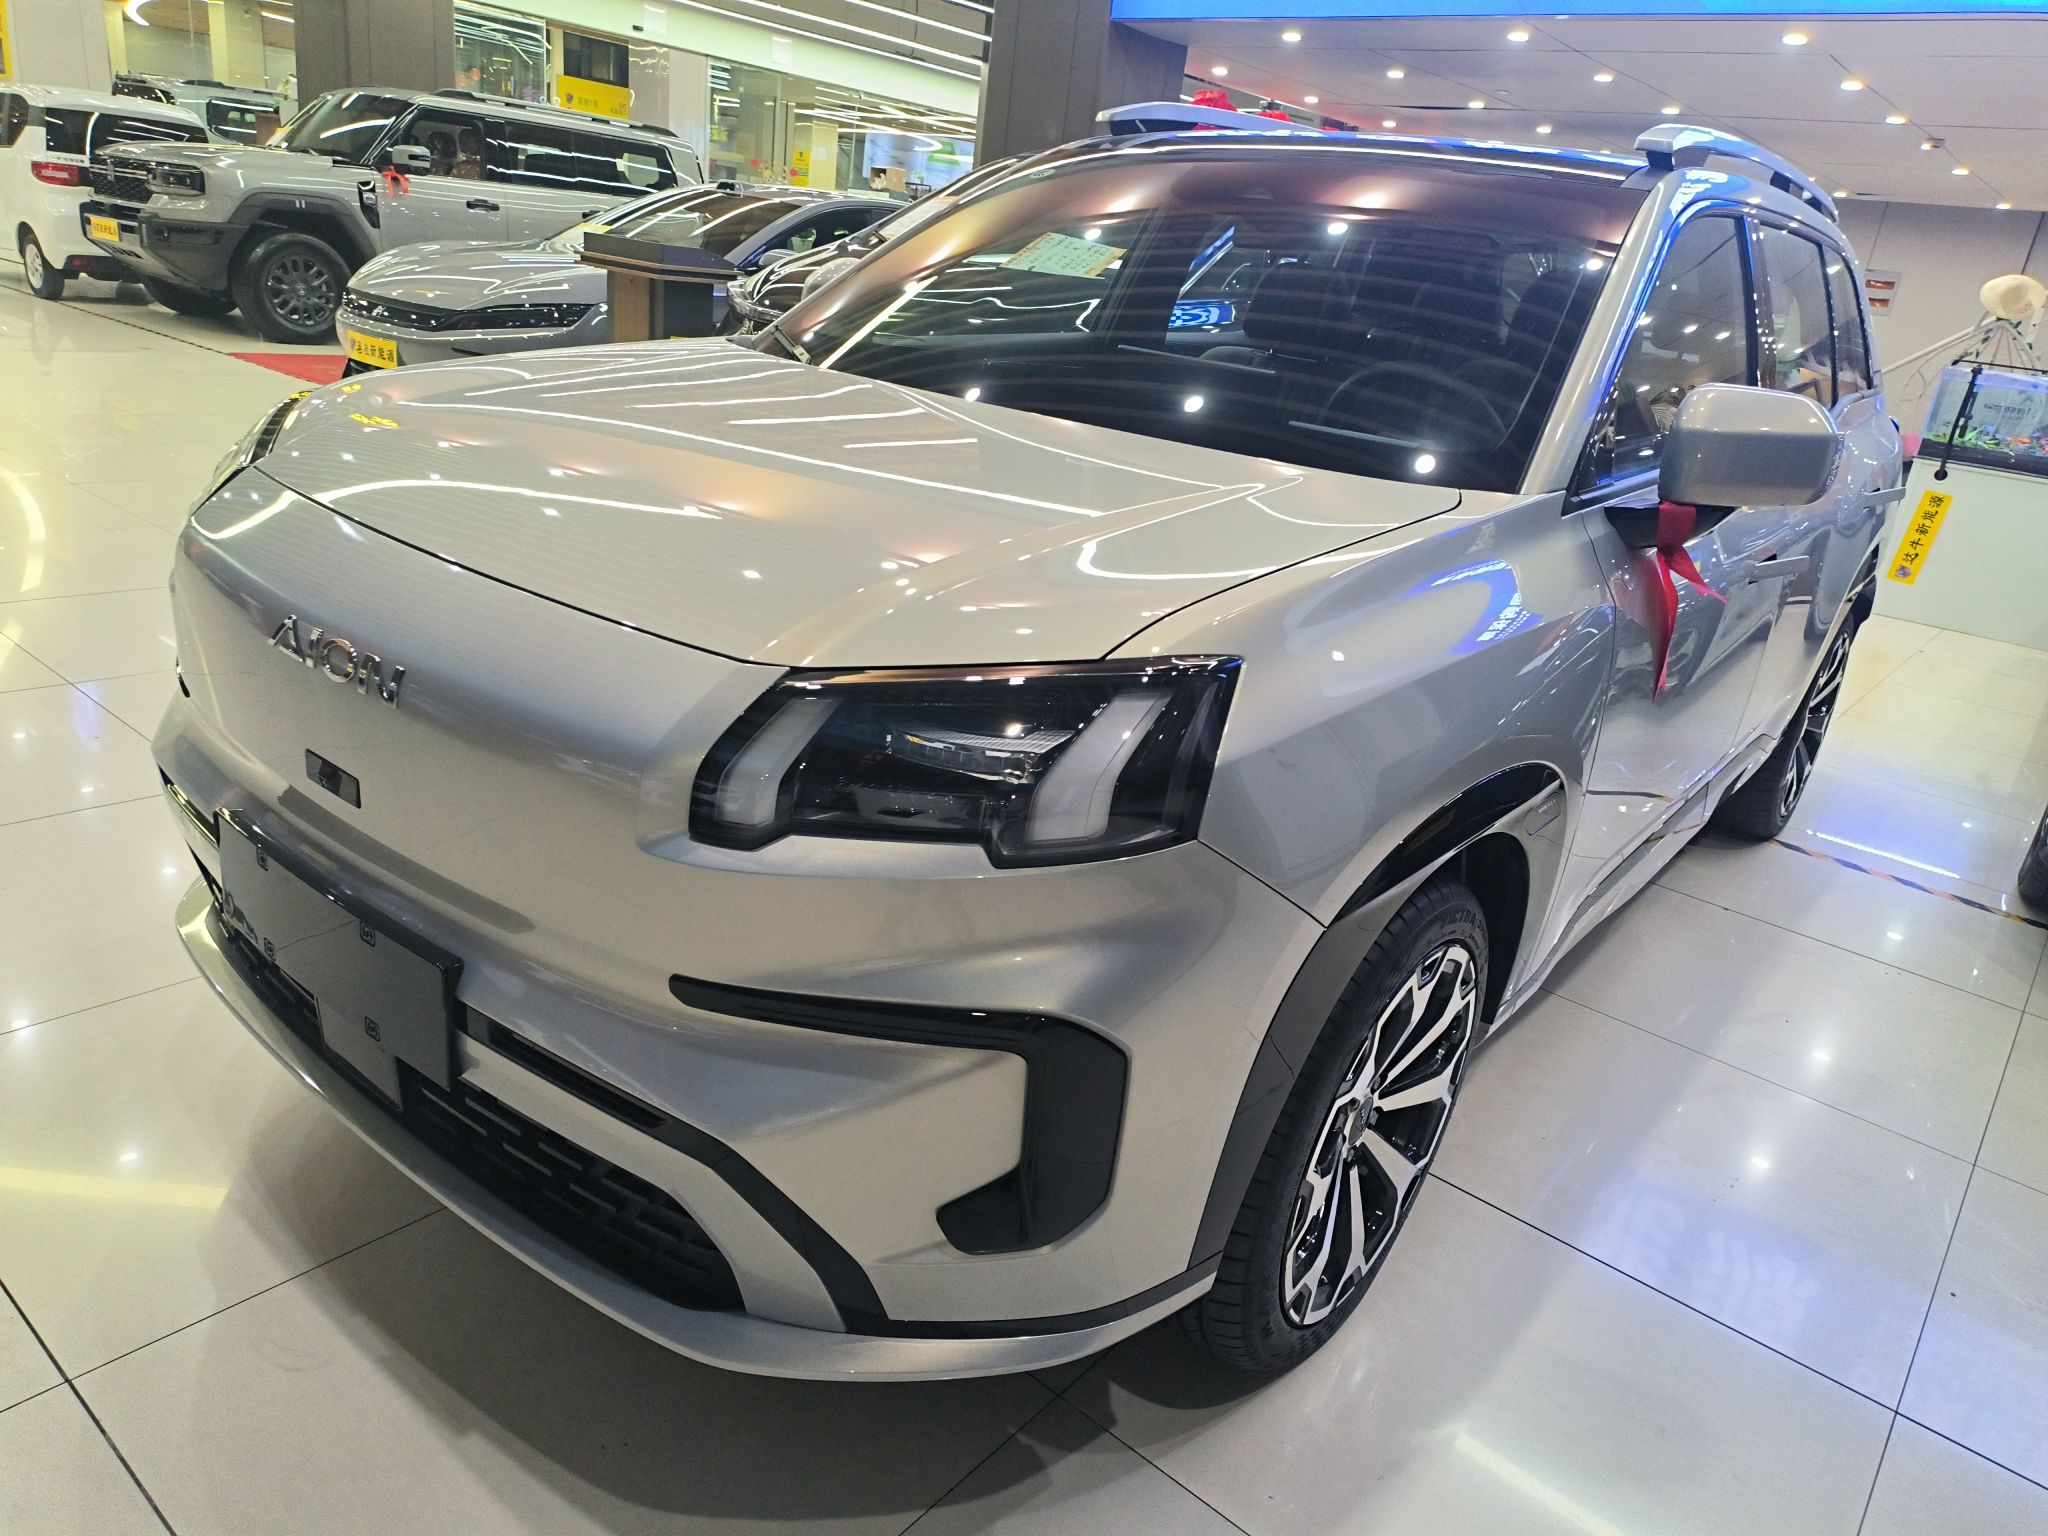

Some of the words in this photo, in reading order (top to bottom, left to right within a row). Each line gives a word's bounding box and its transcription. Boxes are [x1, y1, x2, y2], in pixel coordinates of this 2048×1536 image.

[1902, 495, 1945, 565] 达牛新能源
[267, 614, 406, 709] AION
